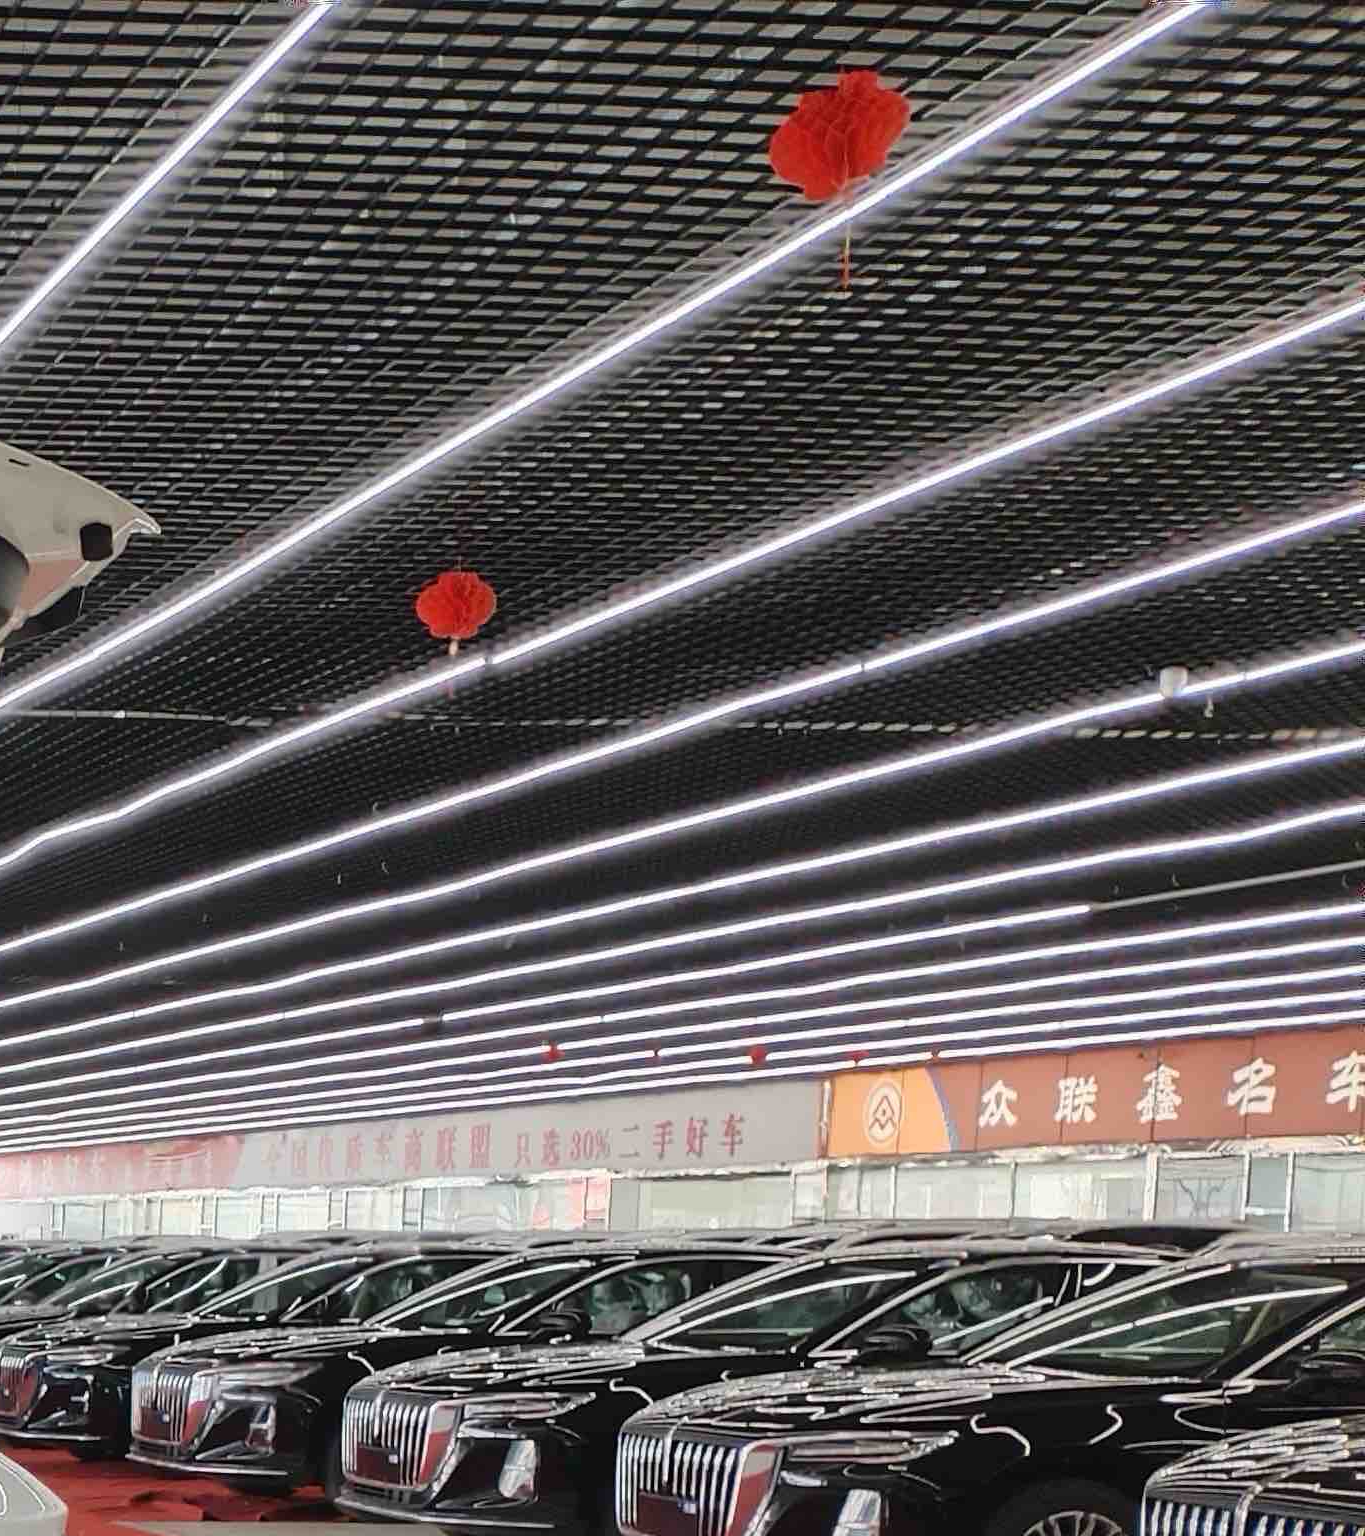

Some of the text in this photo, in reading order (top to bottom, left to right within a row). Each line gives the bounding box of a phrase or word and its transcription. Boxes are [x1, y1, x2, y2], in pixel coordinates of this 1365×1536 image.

[978, 1050, 1365, 1128] 众联鑫名车
